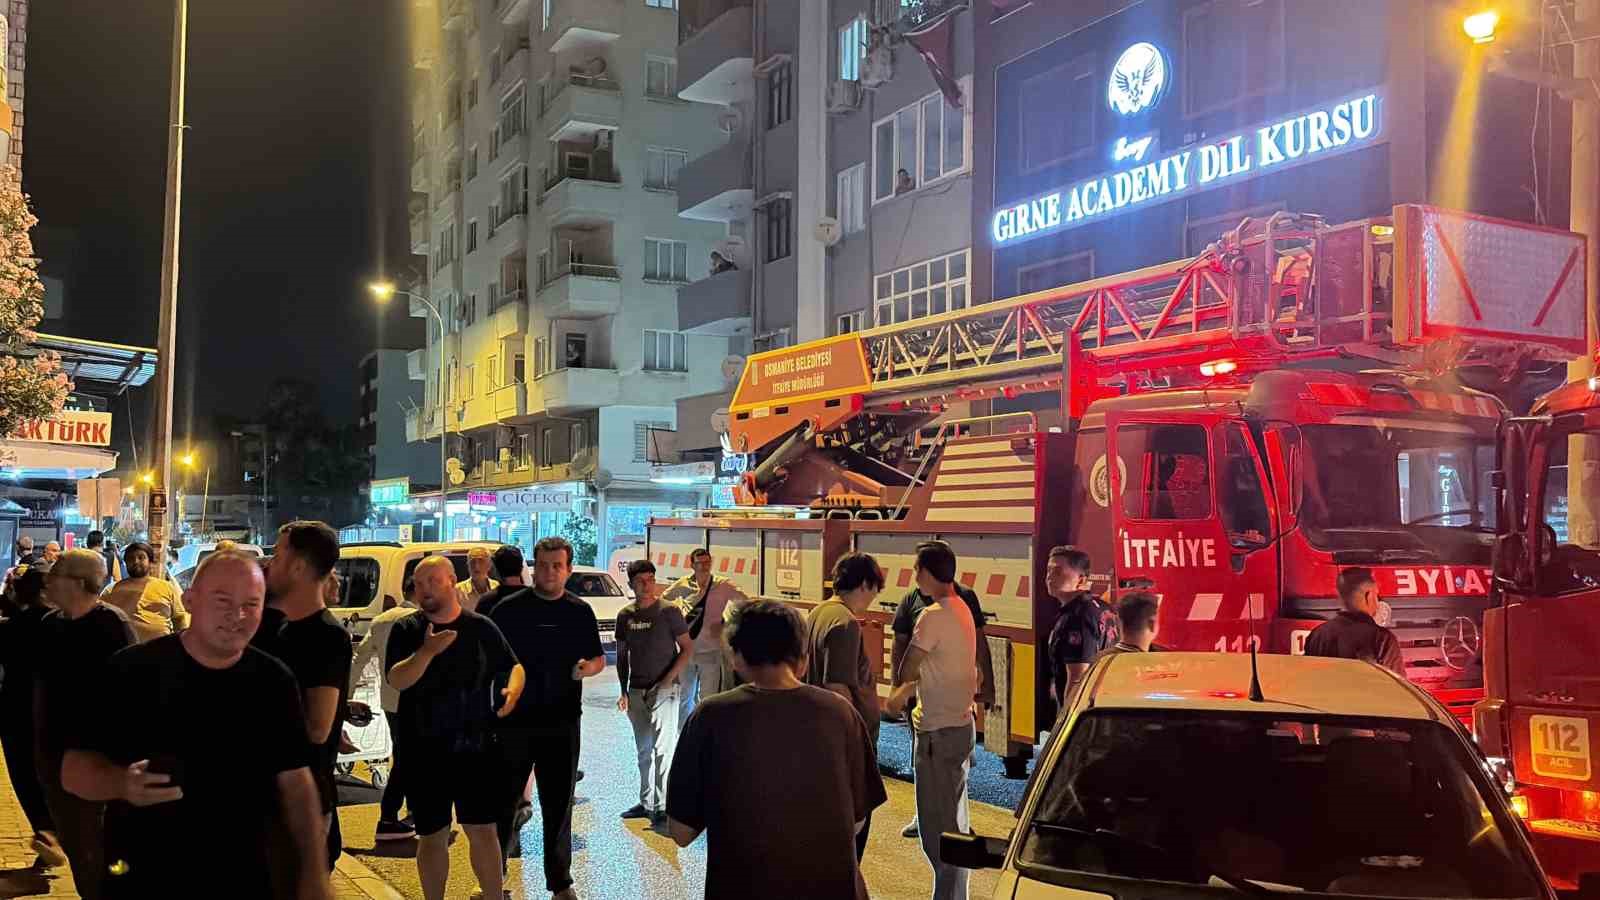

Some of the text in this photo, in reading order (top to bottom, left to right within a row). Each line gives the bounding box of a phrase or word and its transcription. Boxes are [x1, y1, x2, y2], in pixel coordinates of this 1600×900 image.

[993, 193, 1061, 242] GİRNE
[1067, 151, 1191, 222] ACADEMY
[1199, 136, 1251, 184] DİL
[1258, 95, 1375, 167] KURSU
[779, 538, 799, 567] 112
[1123, 530, 1217, 568] İTFAİYE
[1538, 721, 1581, 753] 112
